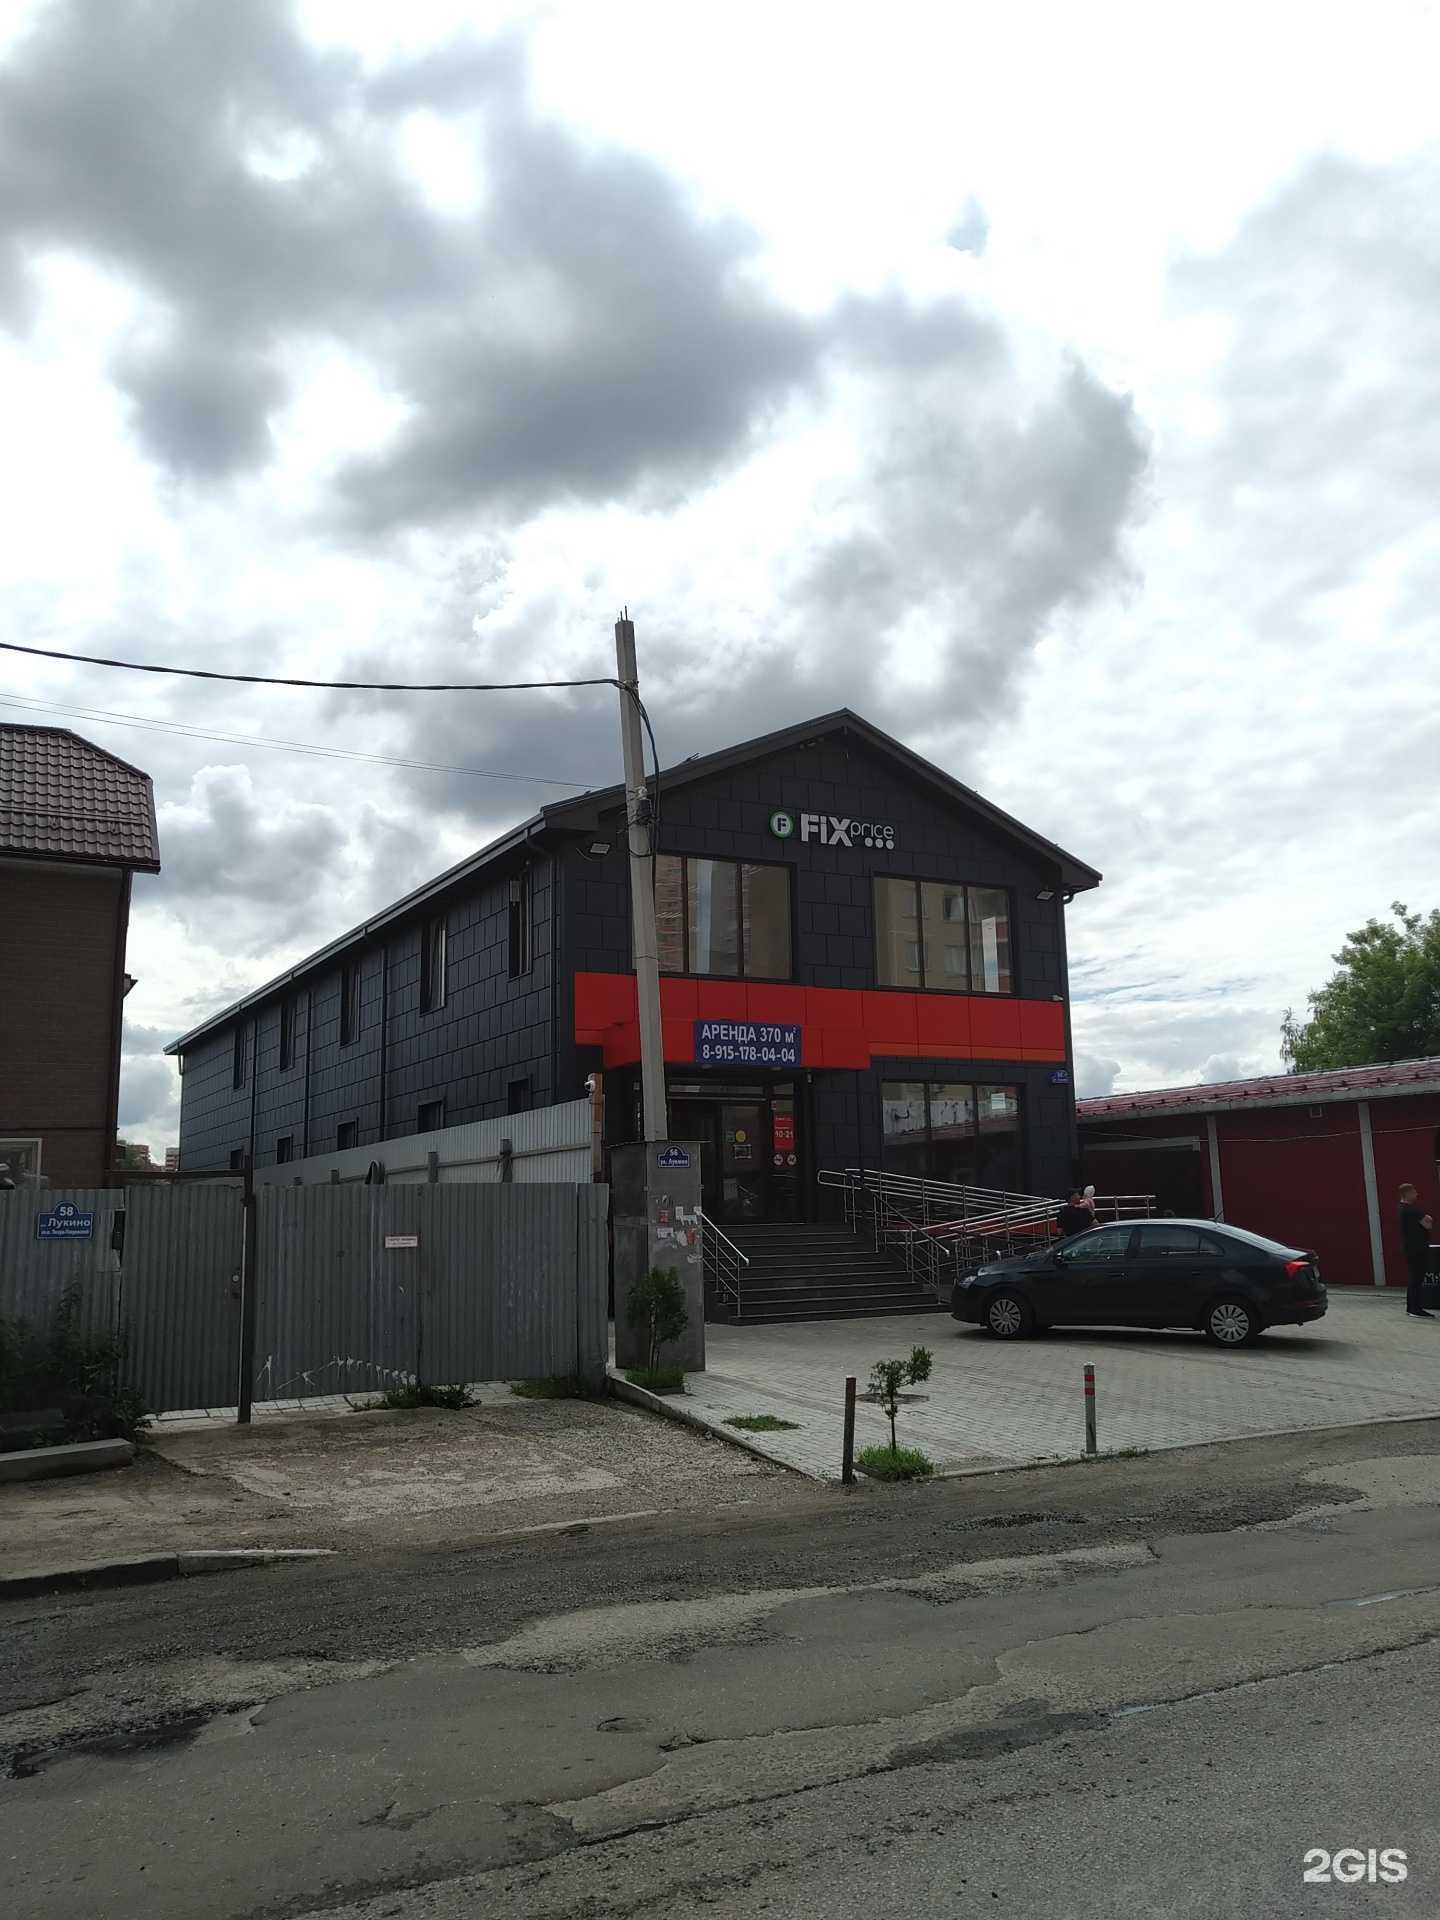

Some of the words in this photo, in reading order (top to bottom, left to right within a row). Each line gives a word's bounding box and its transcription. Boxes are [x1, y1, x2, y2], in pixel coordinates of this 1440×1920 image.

[702, 1024, 757, 1044] АРЕНДА
[760, 1027, 781, 1043] 370
[702, 1044, 796, 1062] 8-915-178-04-04
[60, 1206, 74, 1217] 58
[48, 1218, 91, 1229] Лукино
